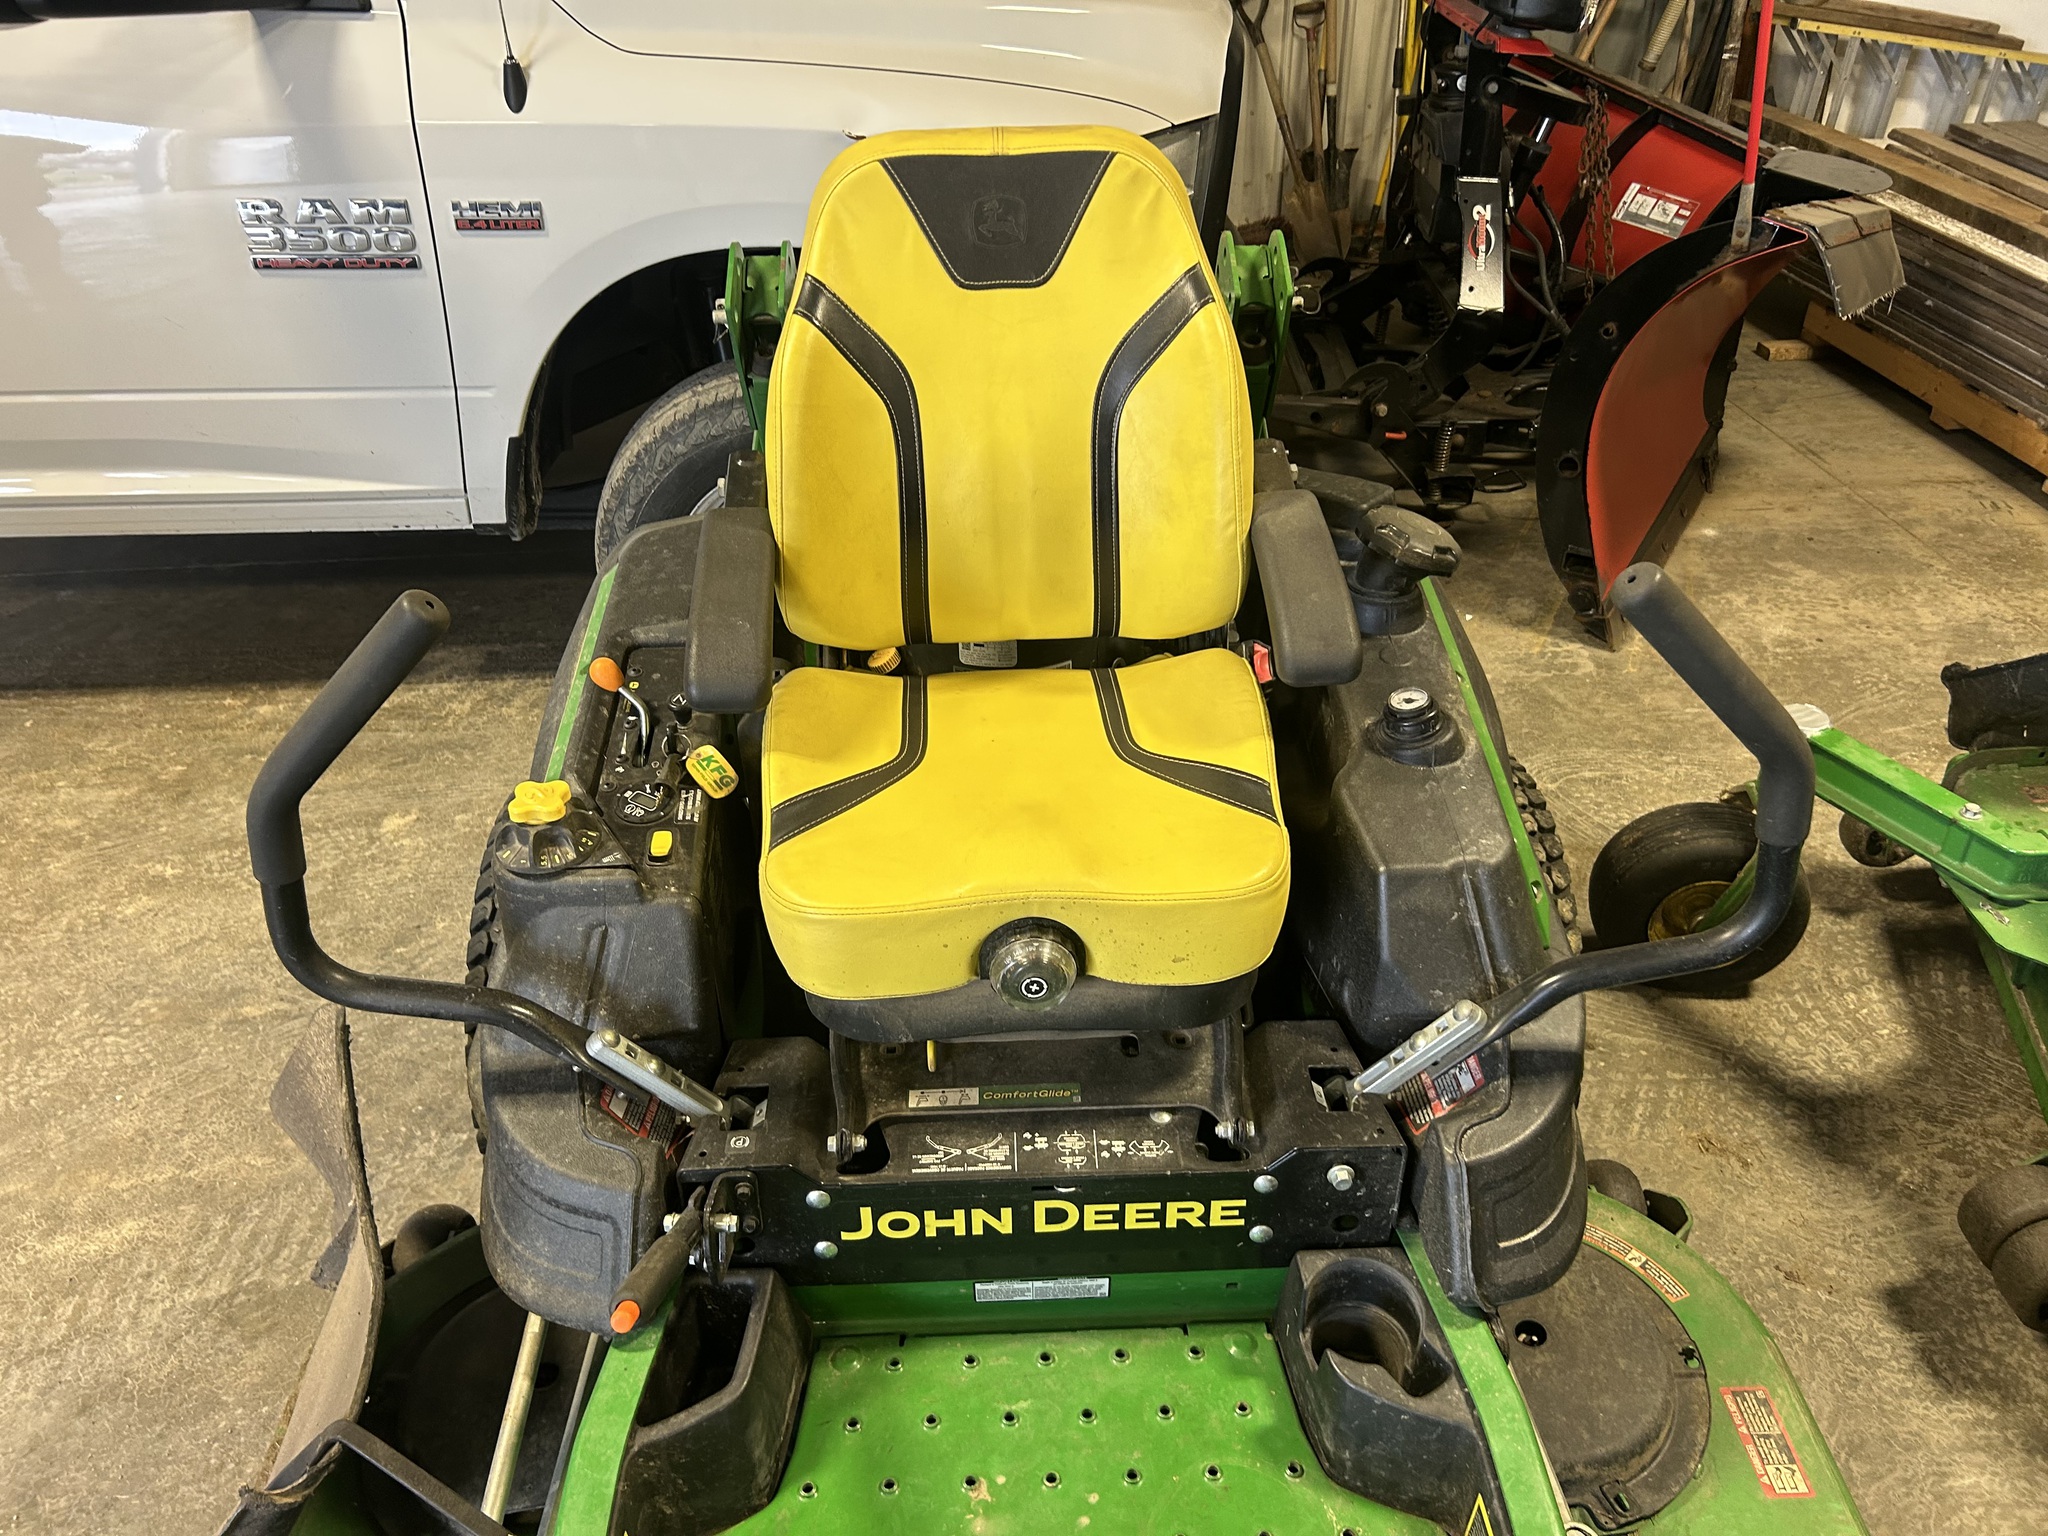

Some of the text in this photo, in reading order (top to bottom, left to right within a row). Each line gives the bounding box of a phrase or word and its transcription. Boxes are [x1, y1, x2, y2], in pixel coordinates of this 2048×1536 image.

[235, 198, 413, 224] RAM
[451, 199, 544, 218] HEMI
[1472, 204, 1492, 221] 2
[456, 219, 541, 231] 6.4 LITER
[243, 226, 417, 253] 3500
[255, 257, 414, 269] HEAVY DUTY
[700, 754, 736, 788] KFG
[840, 1199, 1248, 1241] JOHN DEERE
